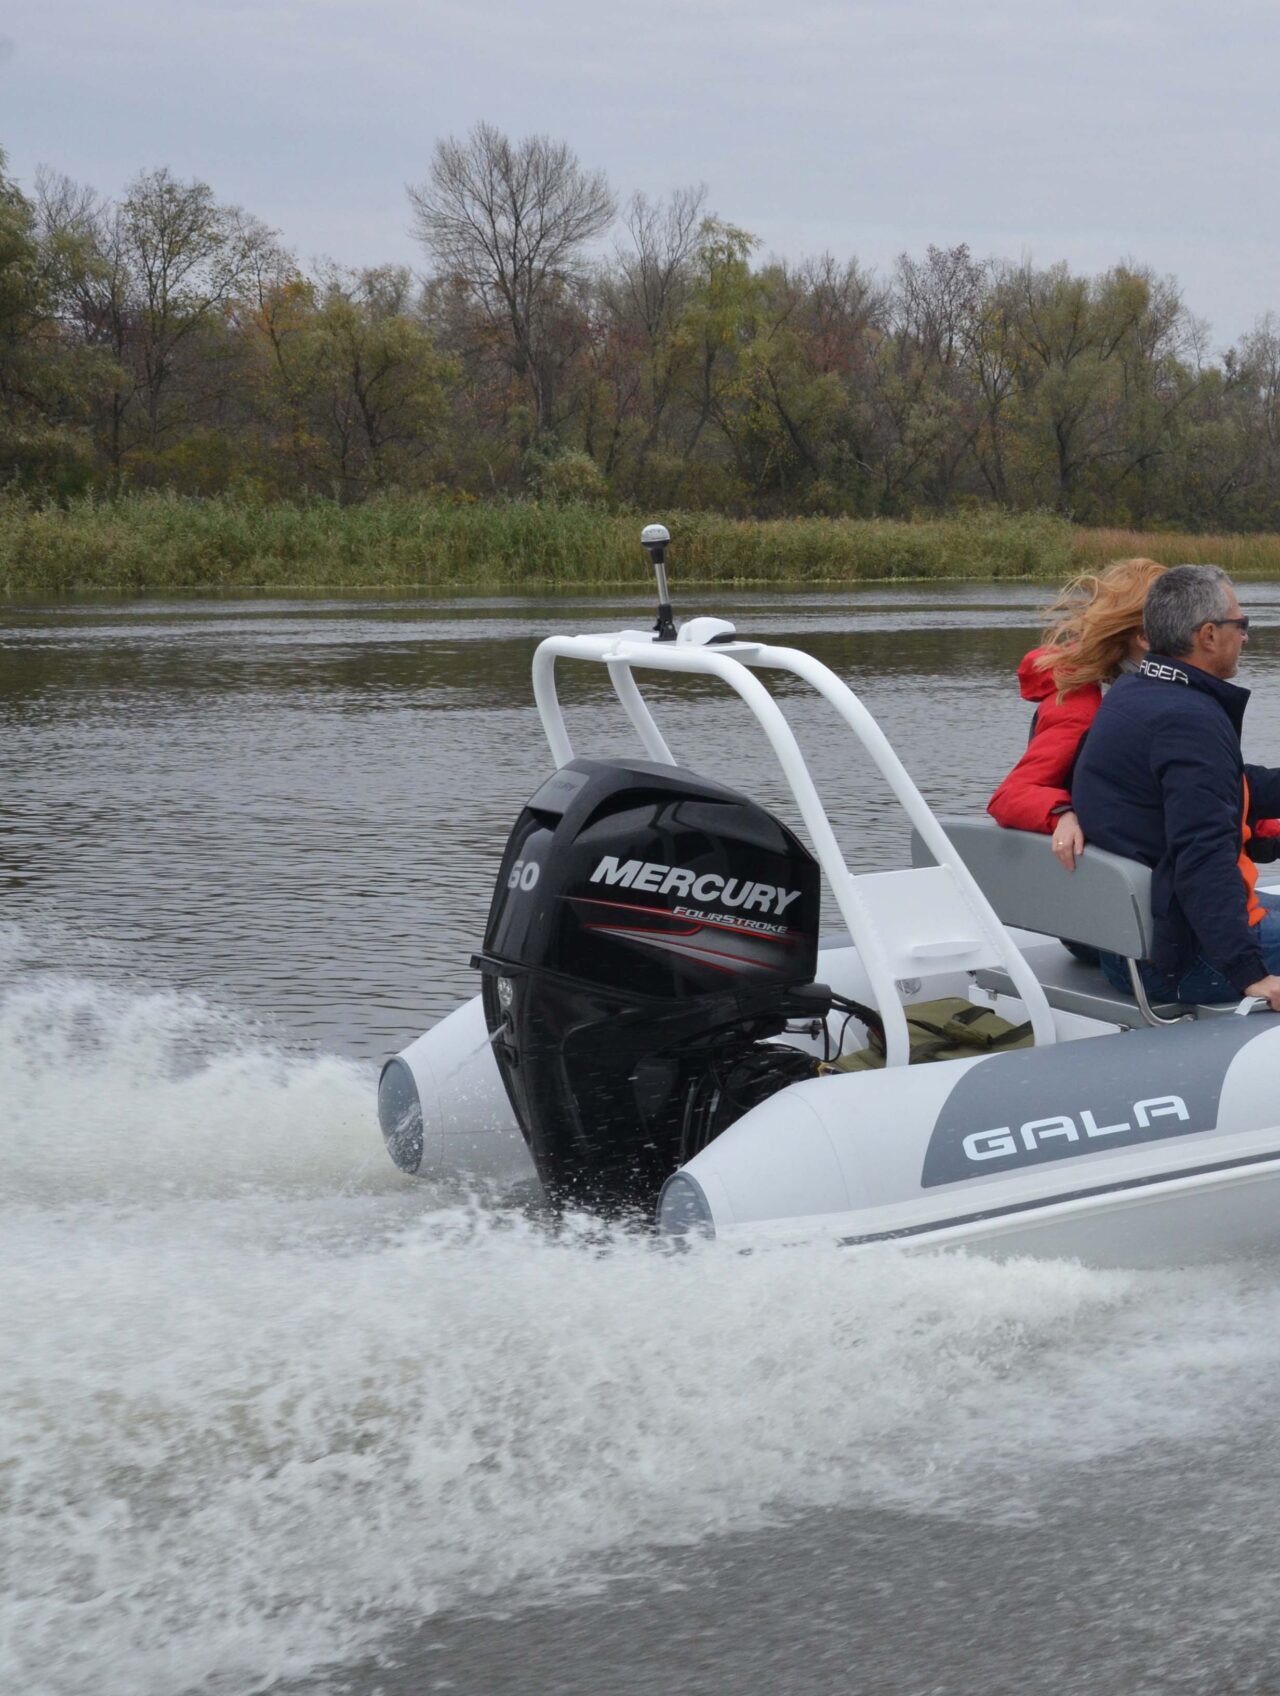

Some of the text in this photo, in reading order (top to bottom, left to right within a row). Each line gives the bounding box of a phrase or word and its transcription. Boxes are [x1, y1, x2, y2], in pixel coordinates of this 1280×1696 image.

[507, 860, 540, 891] 60
[590, 856, 802, 915] MERCURY
[672, 905, 789, 934] FOURSTROKE
[962, 1095, 1190, 1161] GALA
